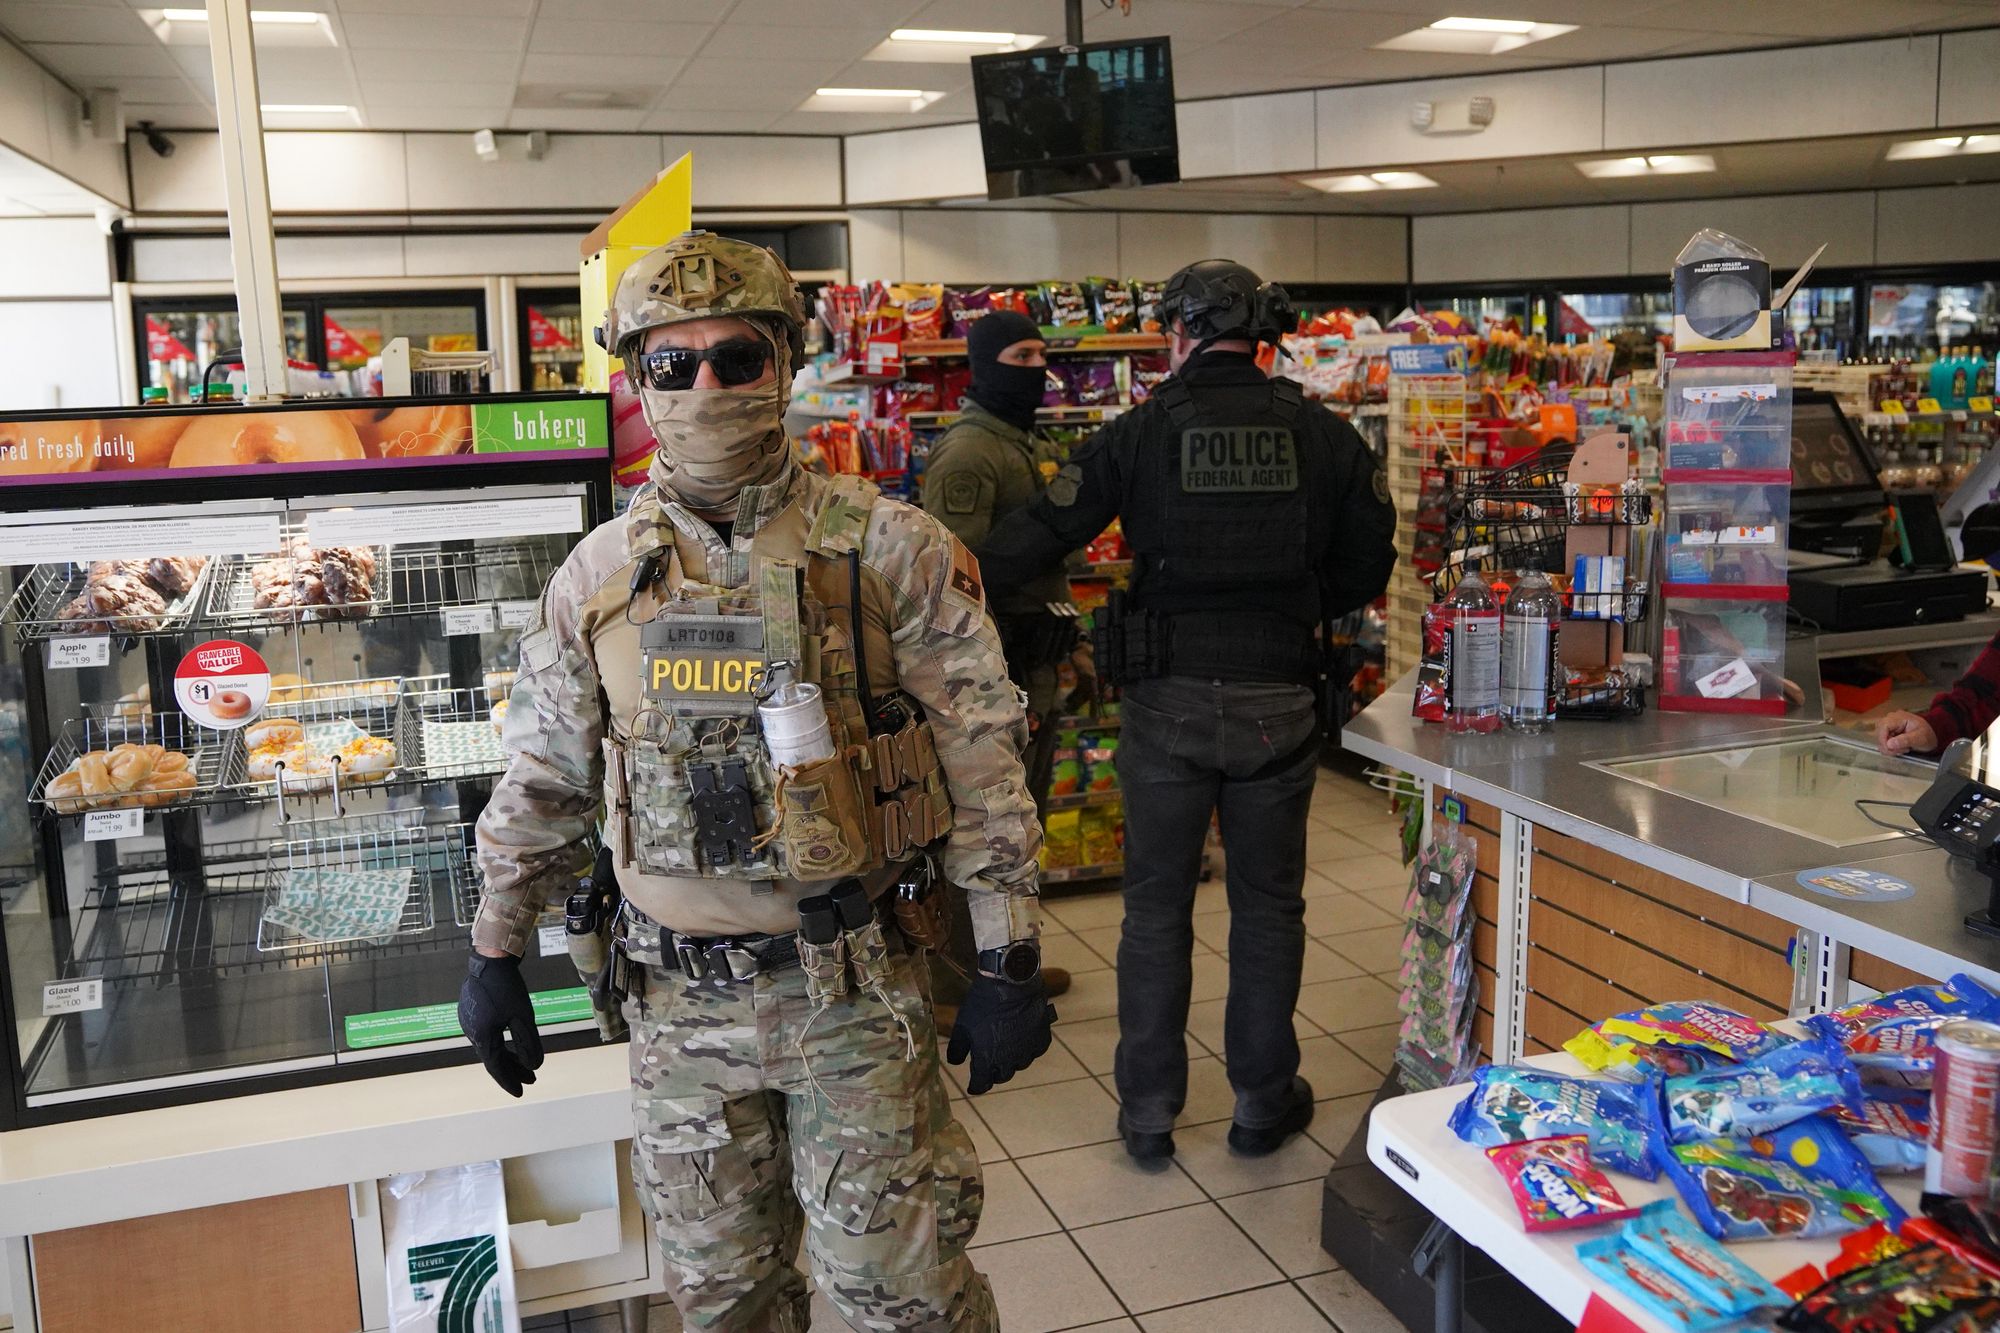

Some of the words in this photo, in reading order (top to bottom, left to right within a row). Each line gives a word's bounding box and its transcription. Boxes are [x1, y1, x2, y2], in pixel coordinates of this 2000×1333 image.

[1391, 350, 1421, 370] FREE
[513, 410, 586, 448] bakery
[38, 435, 84, 460] fresh
[94, 433, 136, 463] daily
[1189, 431, 1290, 467] POLICE
[1187, 469, 1247, 488] FEDERAL
[1251, 468, 1293, 487] AGENT
[59, 644, 88, 652] Apple
[198, 647, 240, 660] CRAVEABLE
[199, 656, 242, 669] VALUE!
[652, 659, 762, 693] POLICE
[194, 684, 209, 700] $1
[90, 813, 121, 821] Jumbo
[1839, 870, 1871, 879] 2
[1873, 878, 1908, 892] $6
[48, 985, 80, 996] Glazed
[1683, 1012, 1748, 1046] GUMMI
[1690, 1006, 1761, 1044] WORMS
